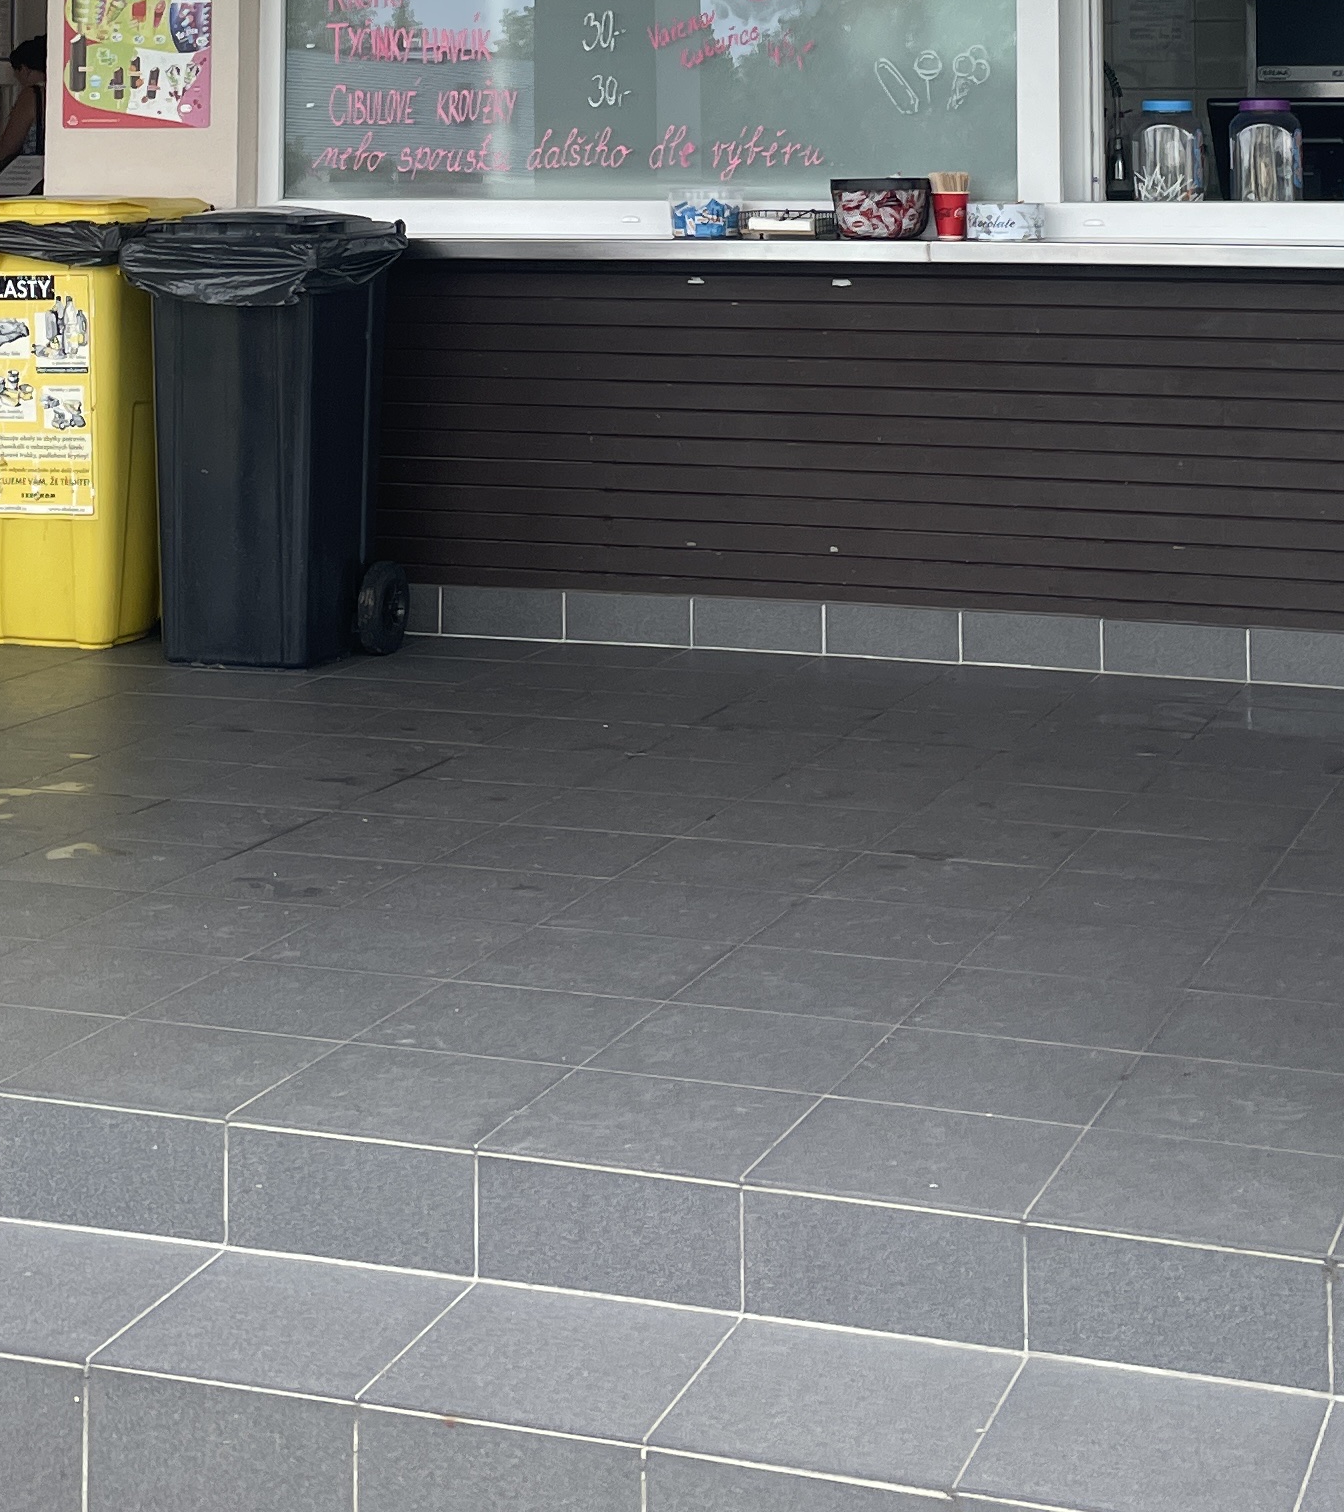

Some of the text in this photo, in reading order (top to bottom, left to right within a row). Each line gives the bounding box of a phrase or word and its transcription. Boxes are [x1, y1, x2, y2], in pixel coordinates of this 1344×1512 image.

[581, 10, 627, 52] 30,-
[587, 74, 632, 108] 30,-
[311, 131, 388, 173] nebo
[648, 125, 696, 170] dle
